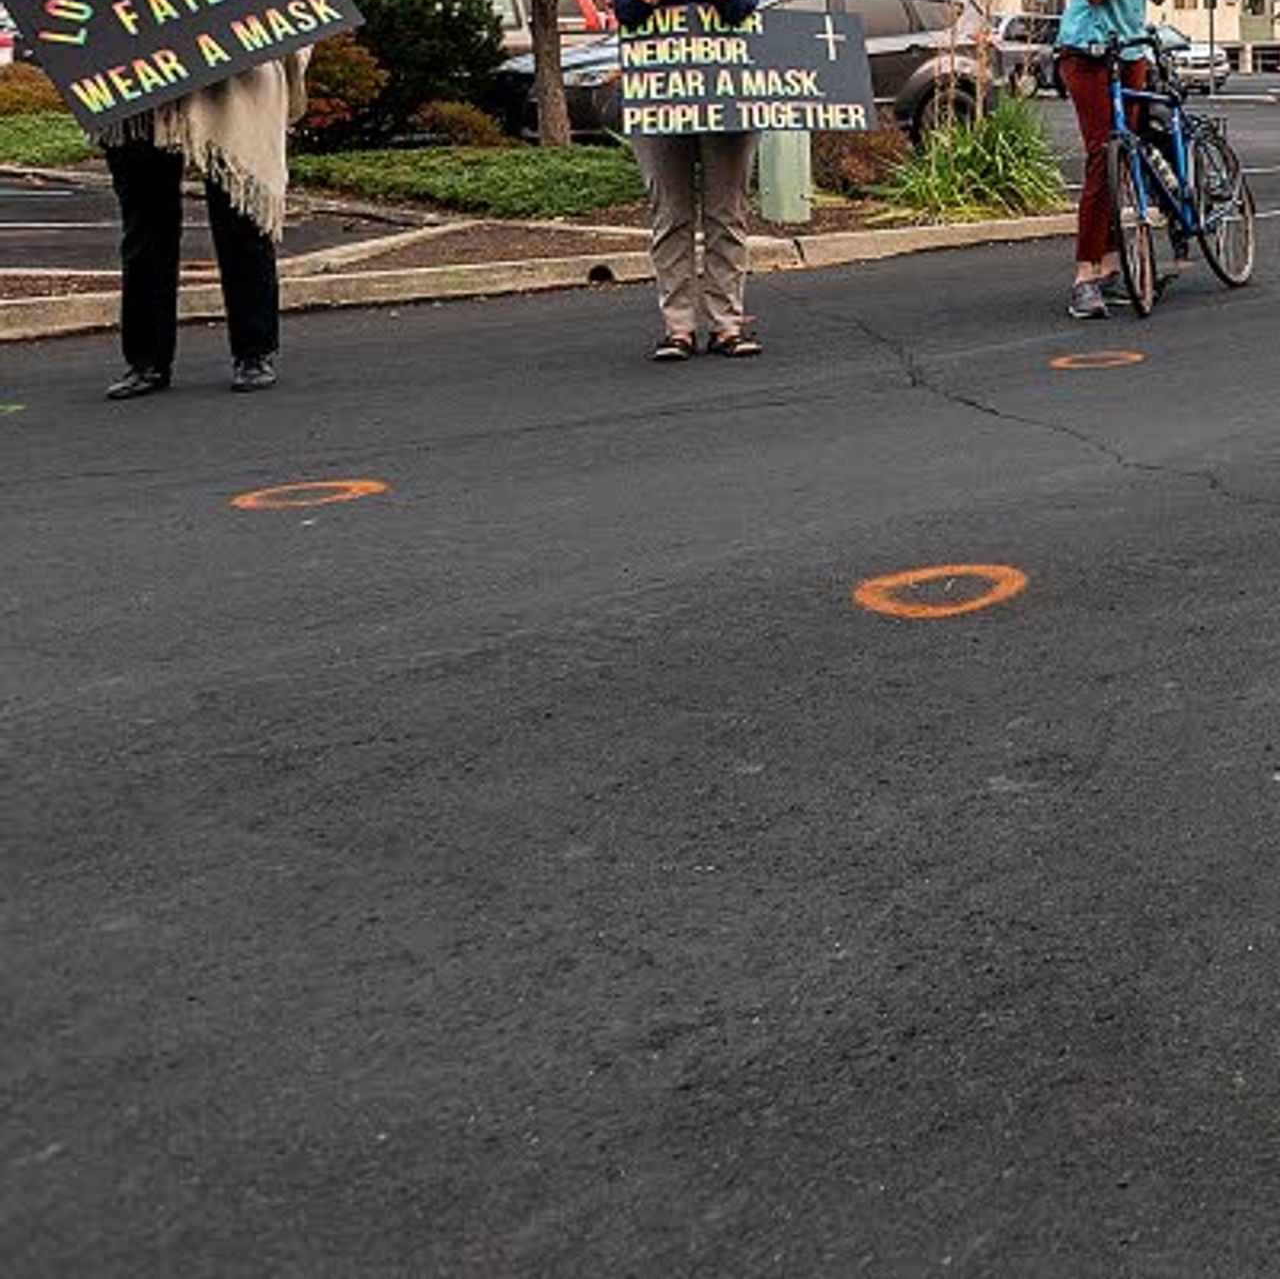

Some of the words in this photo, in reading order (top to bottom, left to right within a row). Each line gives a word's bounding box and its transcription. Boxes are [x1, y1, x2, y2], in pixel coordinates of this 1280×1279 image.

[70, 48, 190, 115] WEAR
[196, 33, 232, 67] A
[623, 70, 705, 99] WEAR
[716, 70, 735, 96] A
[624, 104, 725, 134] PEOPLE
[736, 102, 866, 129] TOGETHER
